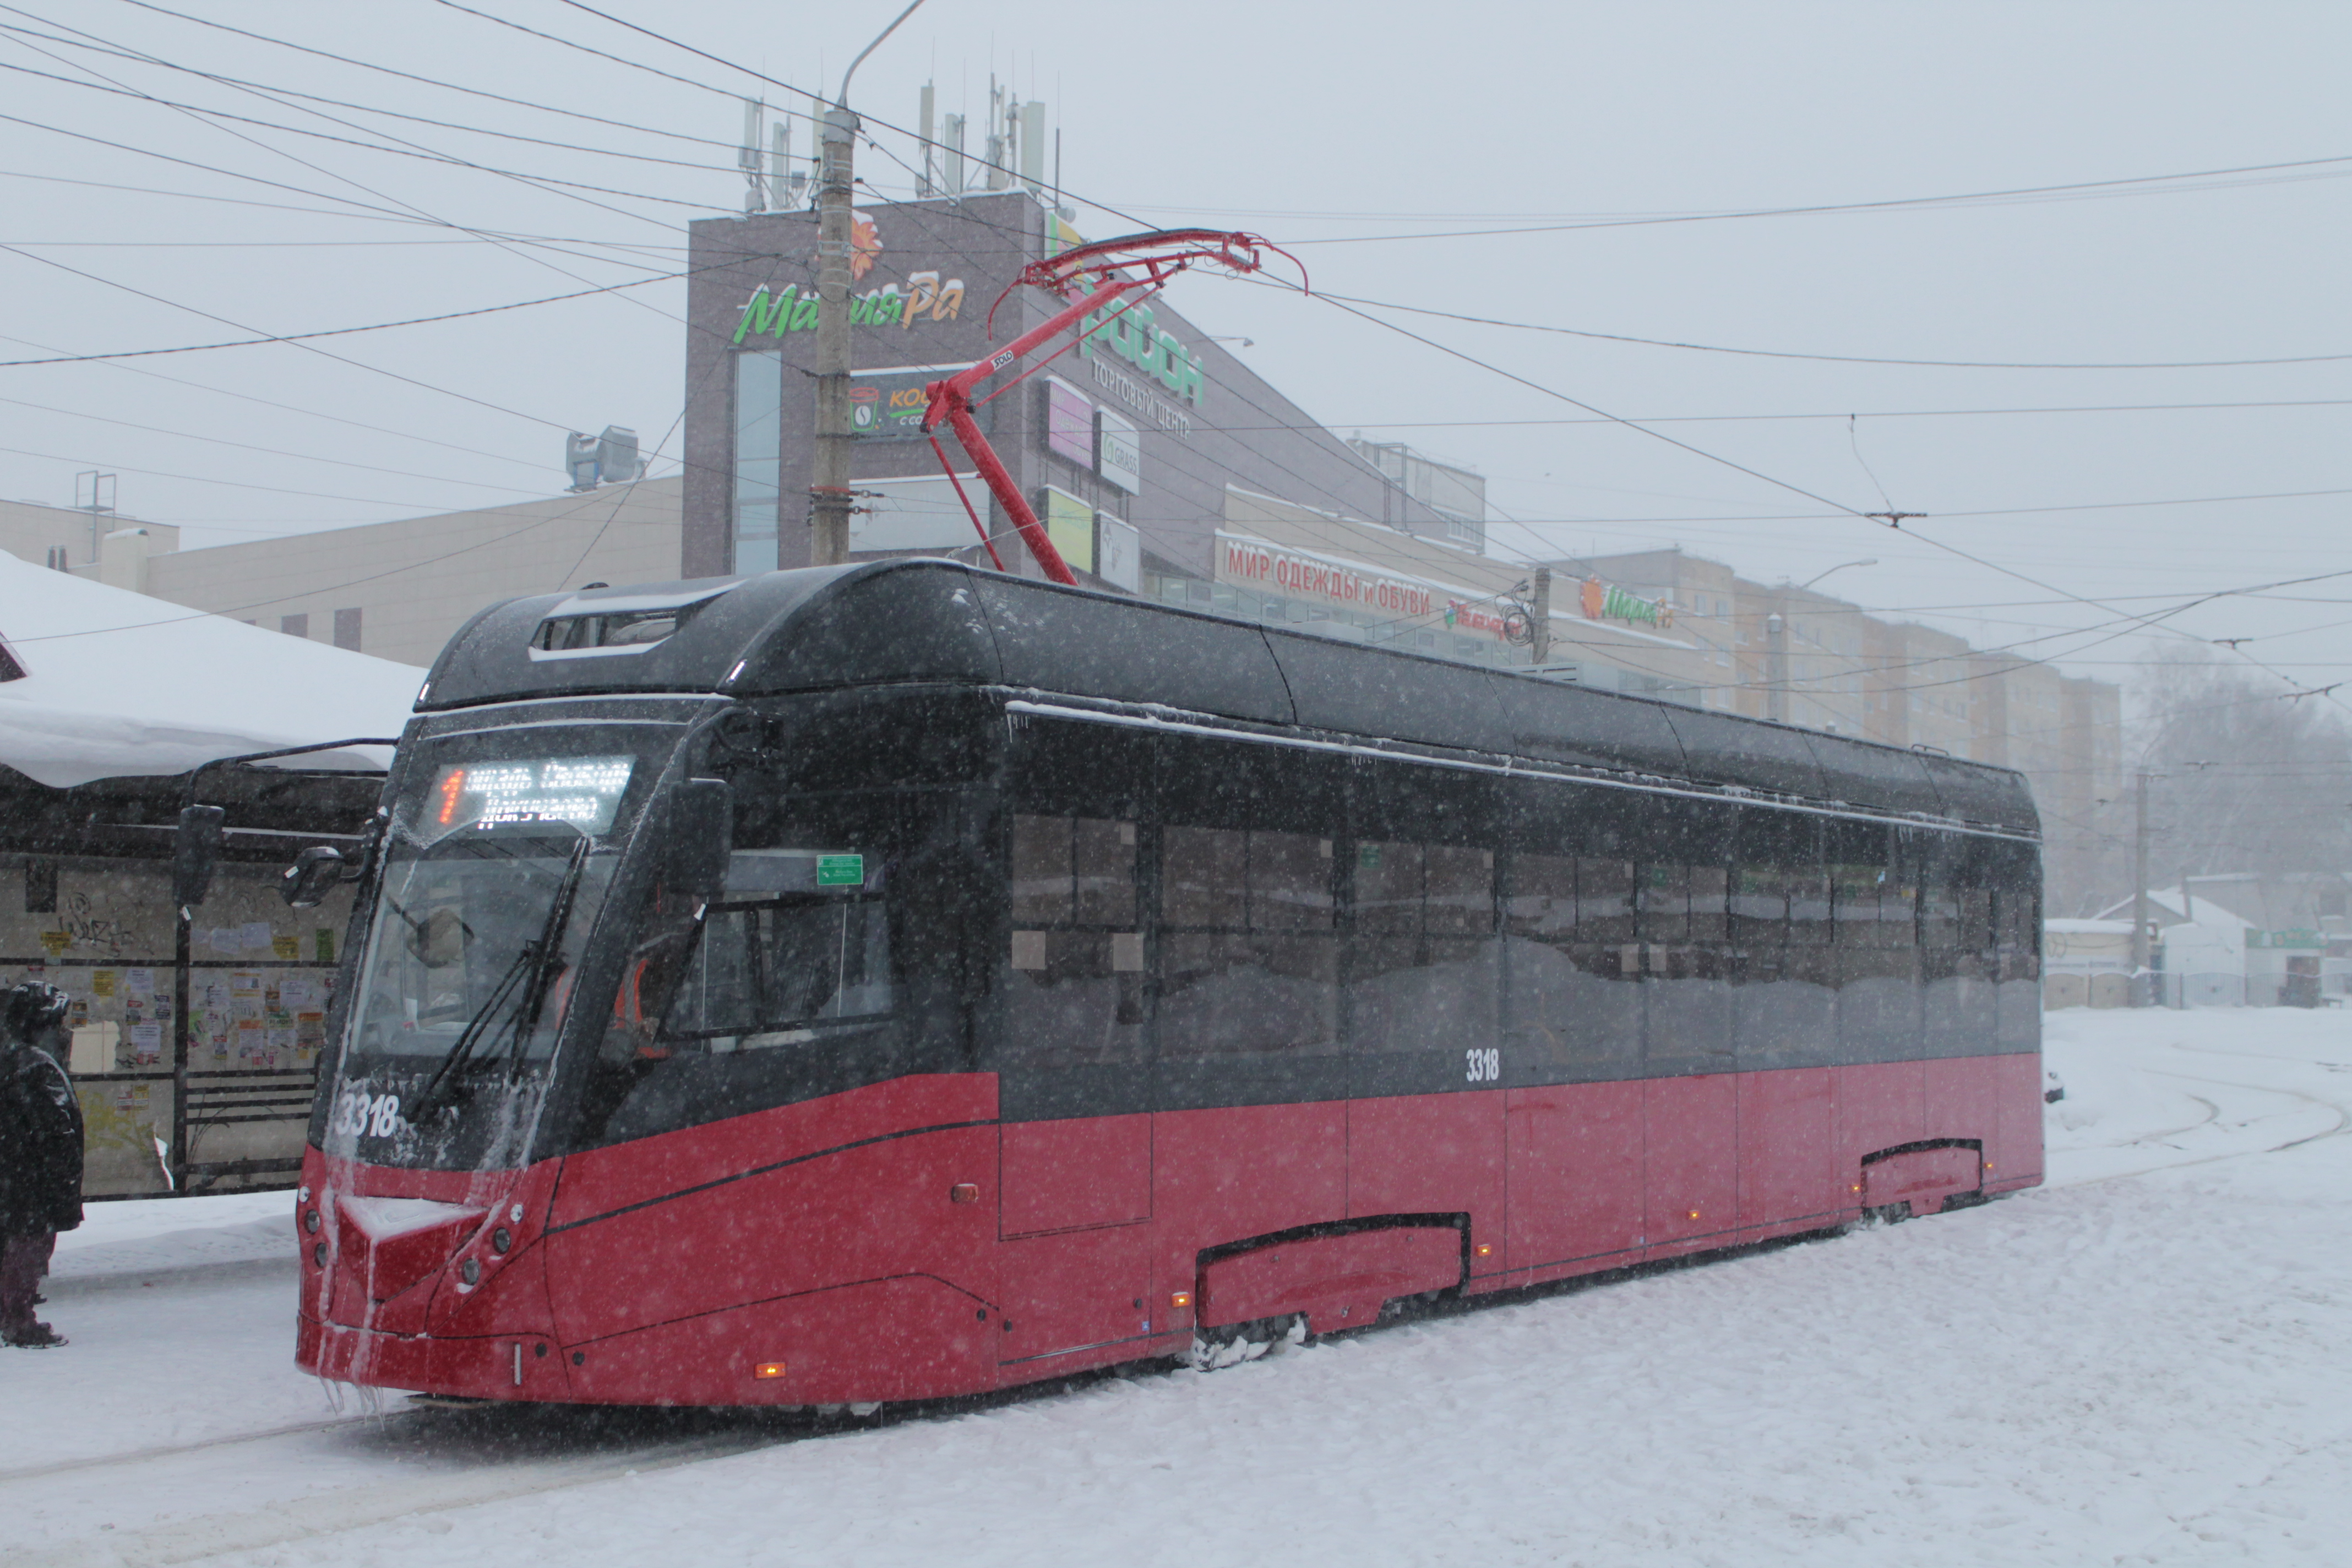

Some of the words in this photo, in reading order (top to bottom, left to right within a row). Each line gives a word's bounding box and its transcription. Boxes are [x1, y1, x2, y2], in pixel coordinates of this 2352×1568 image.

[733, 271, 965, 344] МаияРа
[994, 352, 1012, 368] SOLO
[1092, 356, 1153, 419] ТОРГОВЫЙ
[1156, 400, 1190, 440] ЦЕНТР
[1115, 447, 1137, 475] GRASS
[1228, 547, 1270, 580] МИР
[1276, 559, 1358, 601] ОДЕЖДЫ
[1379, 582, 1430, 617] ОБУВИ
[1466, 1048, 1500, 1082] 3318
[335, 1093, 400, 1137] 3318
